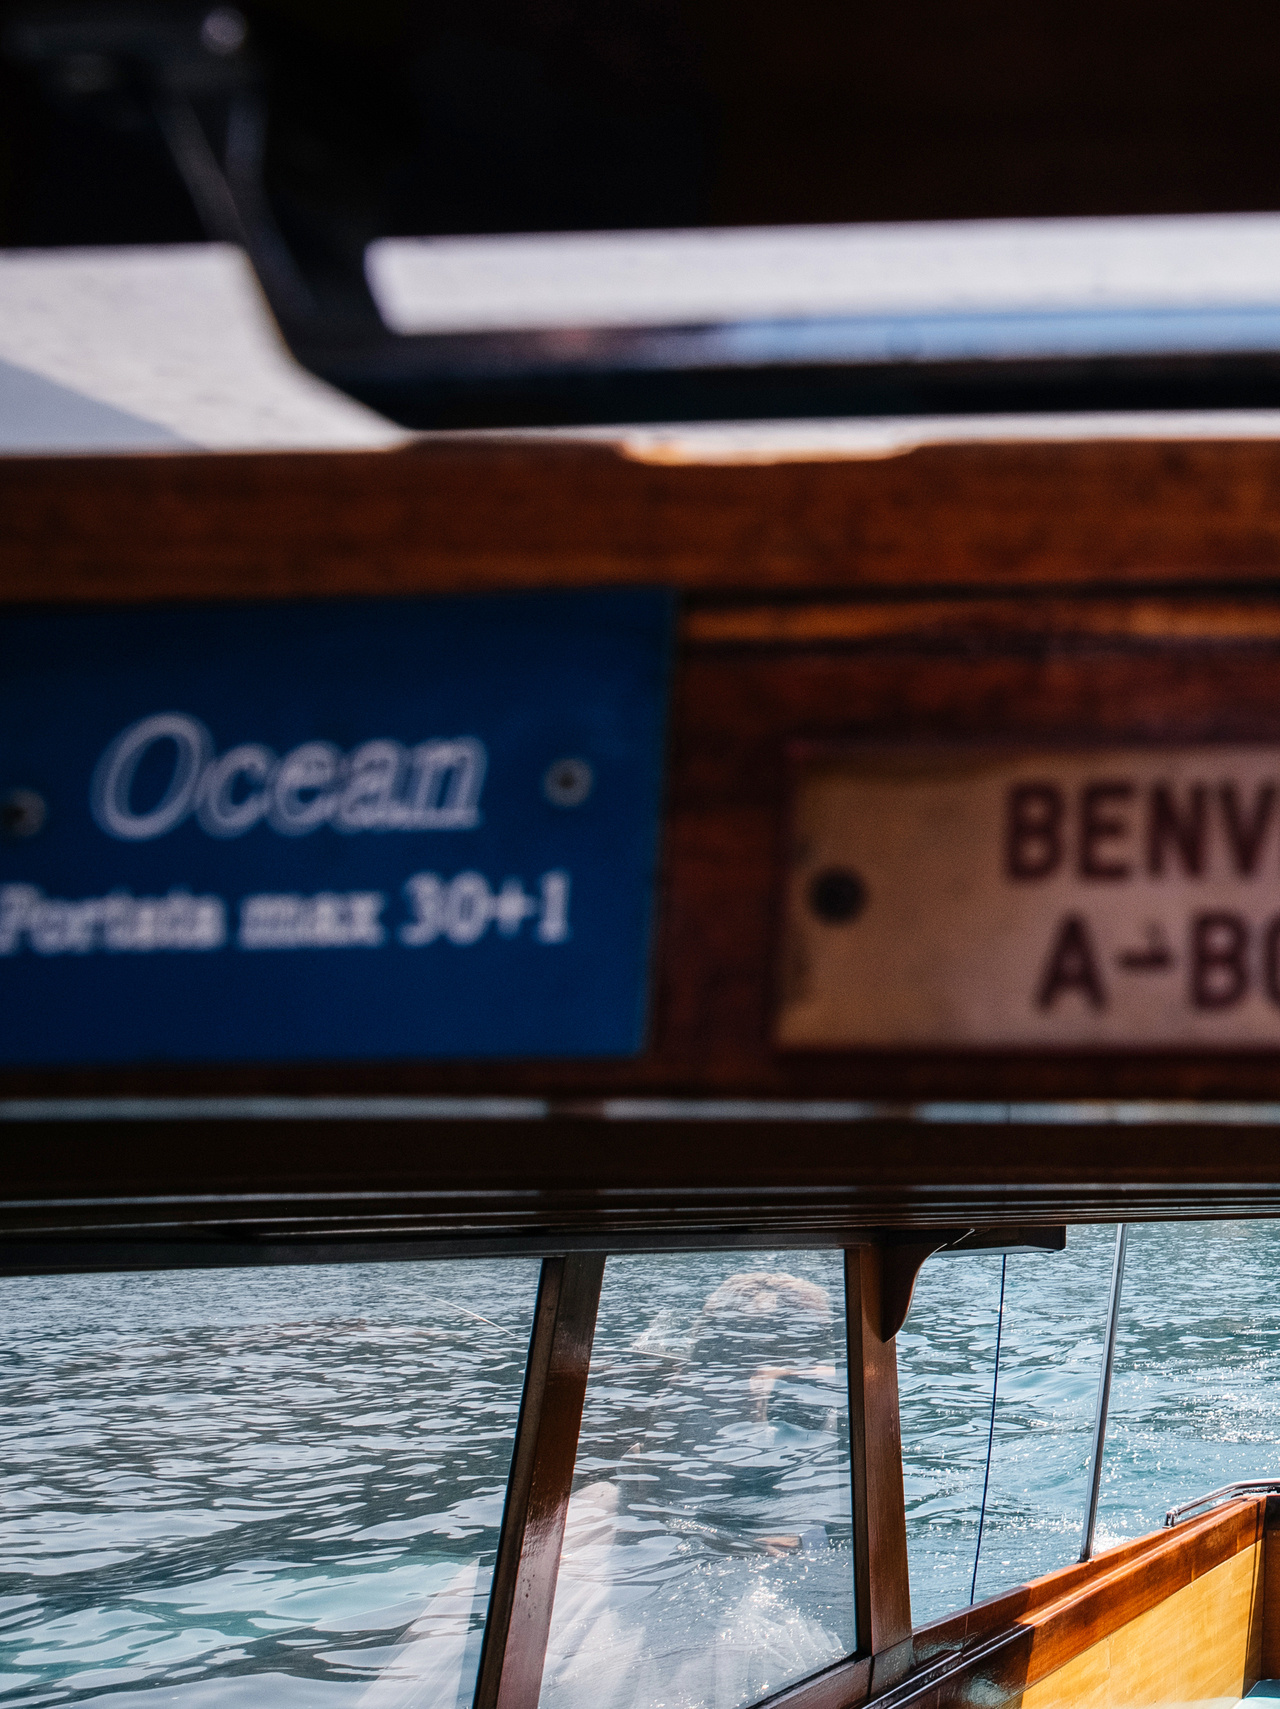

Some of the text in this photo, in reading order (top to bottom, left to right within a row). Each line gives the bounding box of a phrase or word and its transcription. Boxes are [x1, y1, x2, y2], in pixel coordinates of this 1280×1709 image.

[92, 712, 487, 840] Ocean
[238, 891, 386, 947] max
[402, 870, 571, 946] 30+1
